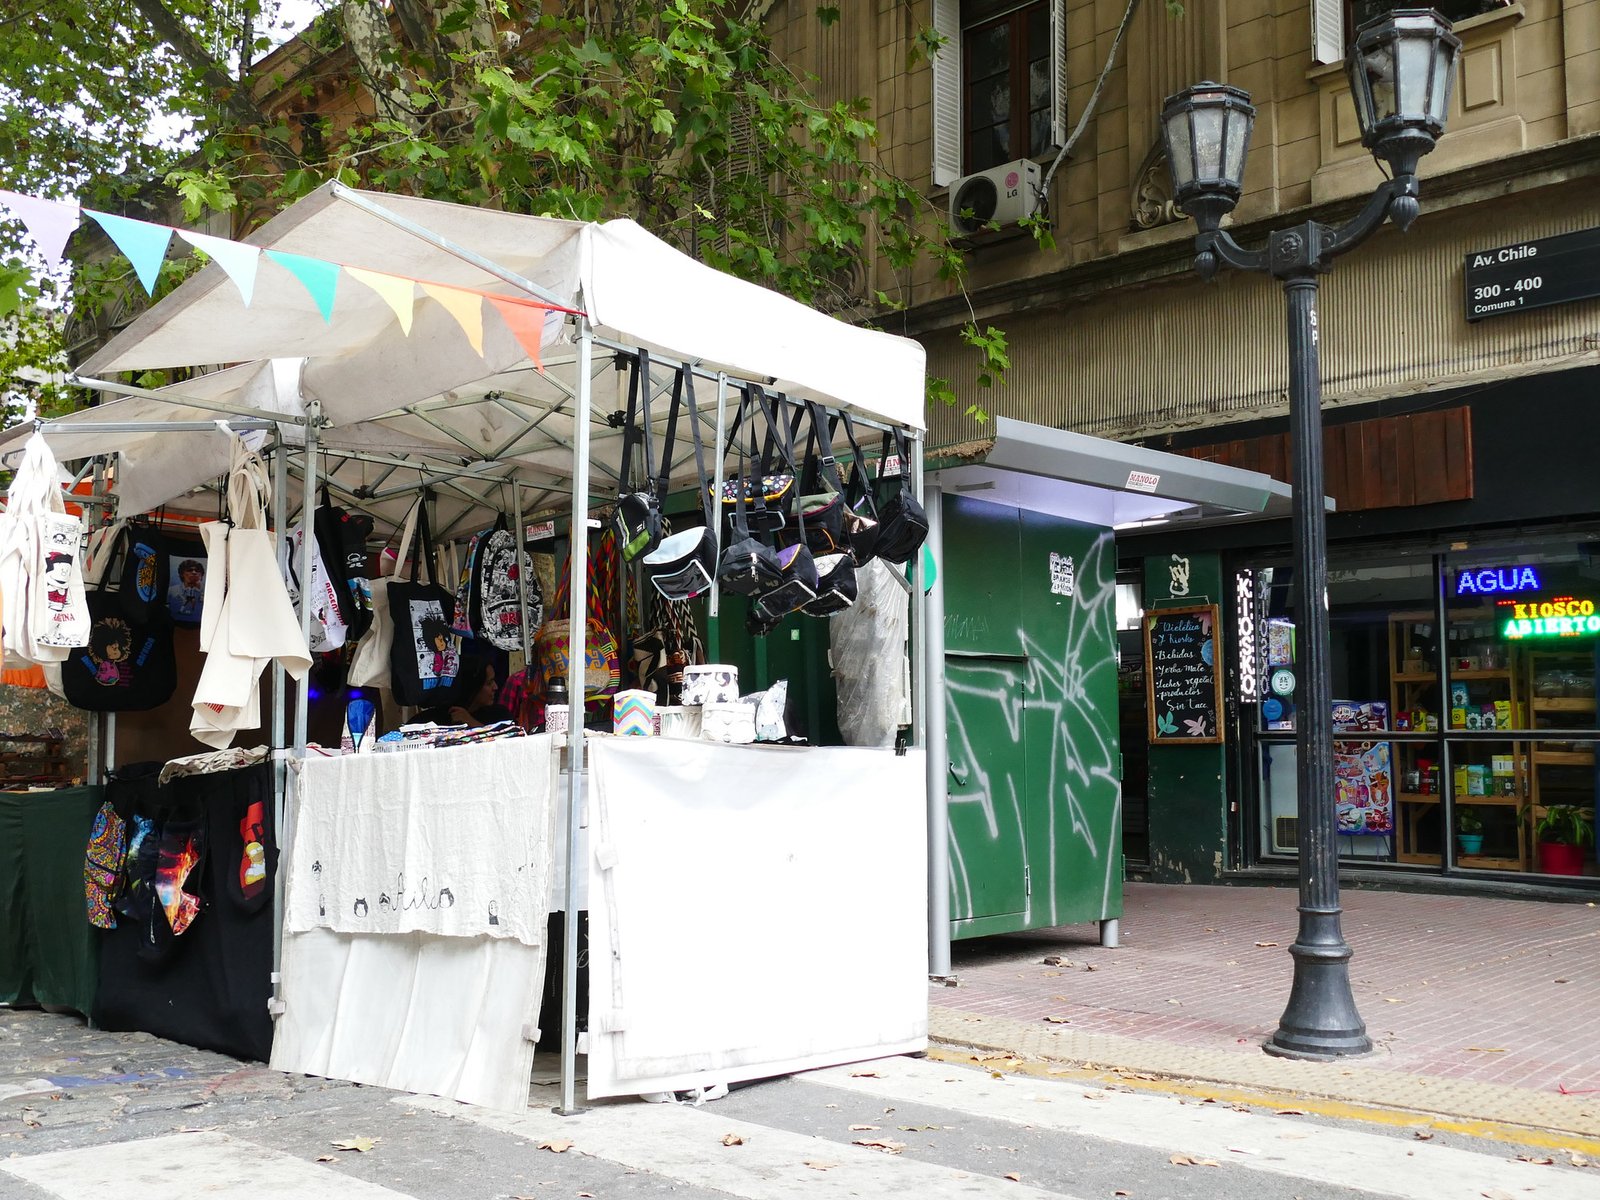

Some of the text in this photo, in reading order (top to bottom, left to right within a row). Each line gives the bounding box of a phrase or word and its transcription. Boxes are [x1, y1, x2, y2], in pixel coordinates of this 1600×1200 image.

[1007, 189, 1018, 199] LG
[1473, 246, 1537, 268] Av. Chile
[1474, 284, 1501, 300] 300
[1514, 276, 1542, 292] 400
[1474, 296, 1524, 313] Comuna 1
[1130, 473, 1158, 485] MANOLO
[1458, 568, 1539, 594] AGUA
[1513, 600, 1594, 619] KIOSCO
[1503, 616, 1600, 636] ABIERTO
[1239, 578, 1256, 695] KIOSKO
[1158, 663, 1183, 677] Yerba
[1166, 700, 1186, 711] Sin
